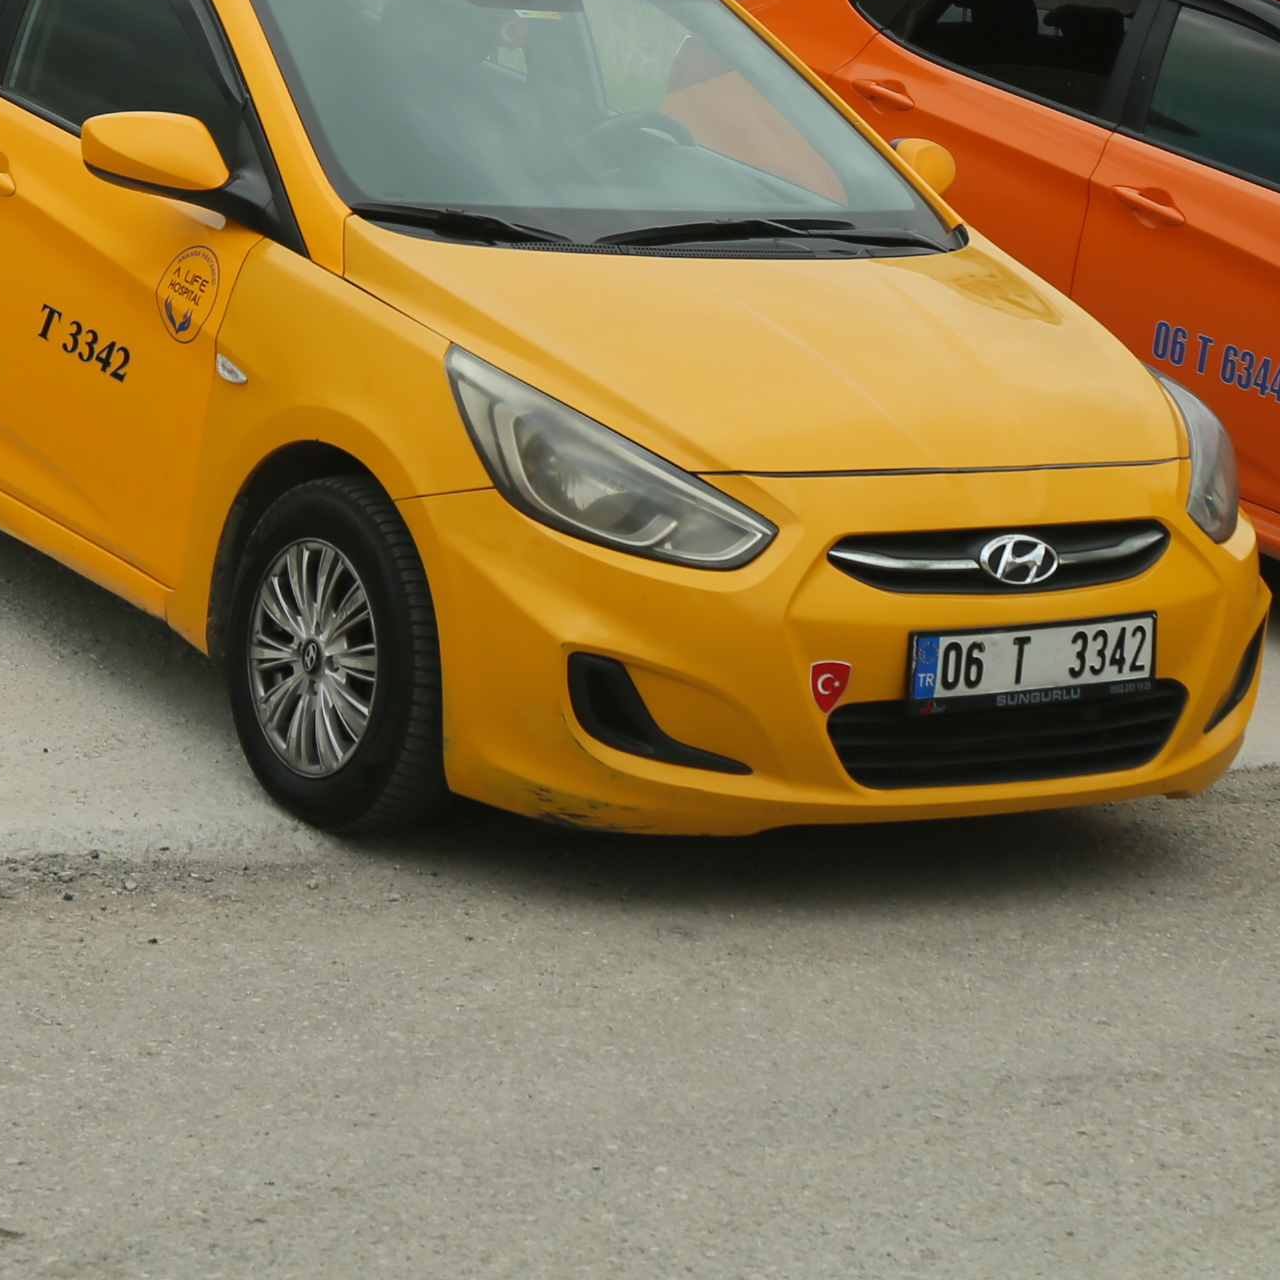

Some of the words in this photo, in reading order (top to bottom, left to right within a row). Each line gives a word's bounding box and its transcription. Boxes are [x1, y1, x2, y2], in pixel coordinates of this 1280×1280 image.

[167, 278, 202, 307] HOSPITAL
[184, 270, 210, 293] LIFE
[37, 303, 63, 342] T
[62, 320, 131, 383] 3342
[1152, 320, 1189, 367] 06
[1196, 333, 1215, 376] T
[940, 640, 986, 691] 06
[1013, 635, 1032, 685] T
[1068, 625, 1148, 680] 3342
[918, 673, 935, 688] TR
[996, 687, 1081, 707] SUNGURLU
